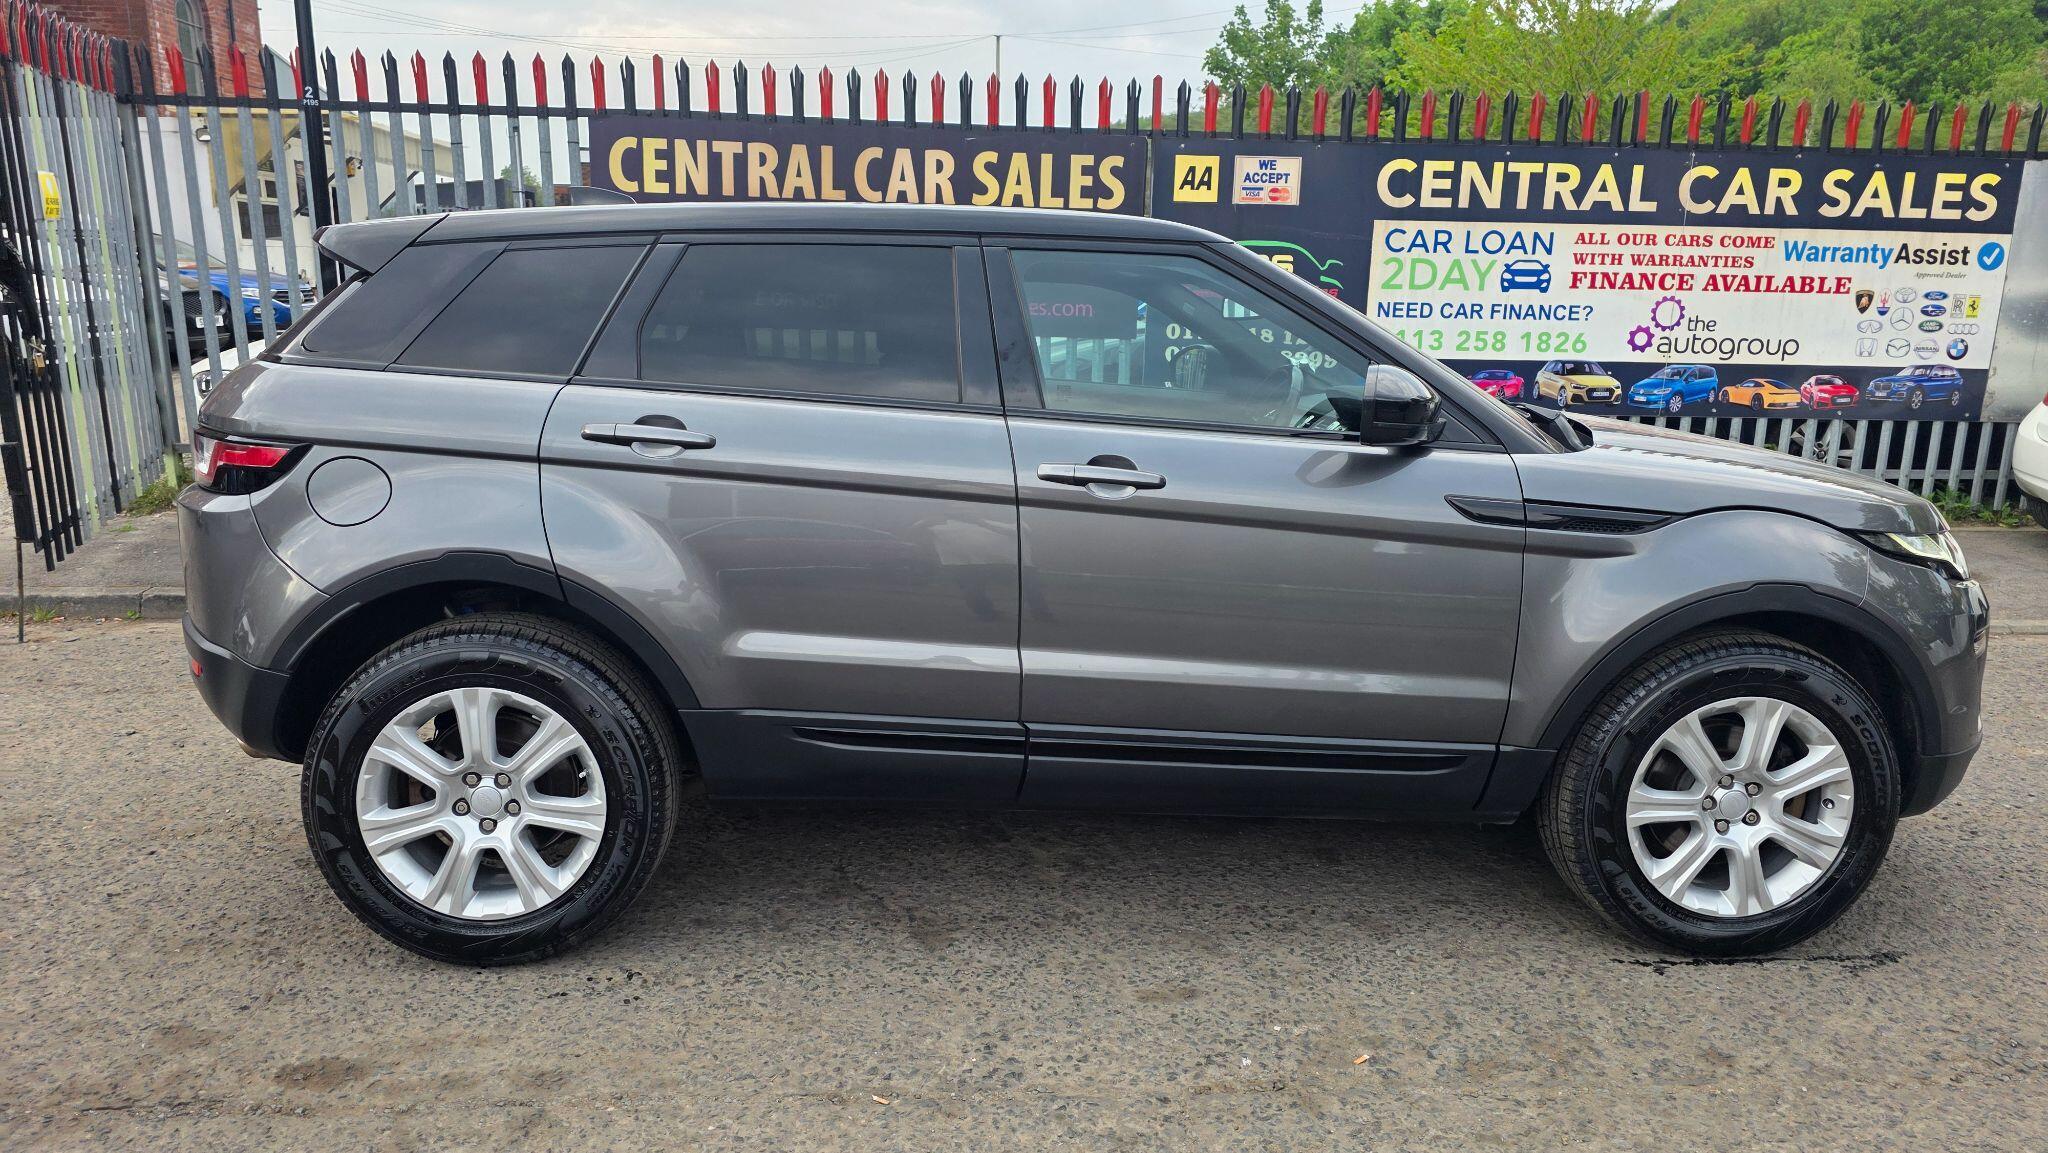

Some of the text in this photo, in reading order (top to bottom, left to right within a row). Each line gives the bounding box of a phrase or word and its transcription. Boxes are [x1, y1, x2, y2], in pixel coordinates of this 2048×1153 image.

[305, 86, 313, 98] 2
[608, 136, 1126, 210] CENTRAL CAR SALES
[1259, 159, 1277, 171] WE
[1178, 165, 1213, 191] AA
[1243, 172, 1291, 184] ACCEPT
[1376, 158, 2002, 222] CENTRAL CAR SALES
[1385, 228, 1555, 255] CAR LOAN
[1574, 232, 1776, 249] ALL OUR CARS COME
[1573, 253, 1755, 269] WITH WARRANTIES
[1380, 257, 1498, 291] 2DAY
[1568, 272, 1852, 295] FINANCE AVAILABLE
[1377, 302, 1594, 322] NEED CAR FINANCE?
[1687, 315, 1717, 332] the
[1455, 330, 1507, 352] 258
[1520, 331, 1588, 353] 1826
[1656, 334, 1800, 361] autogroup
